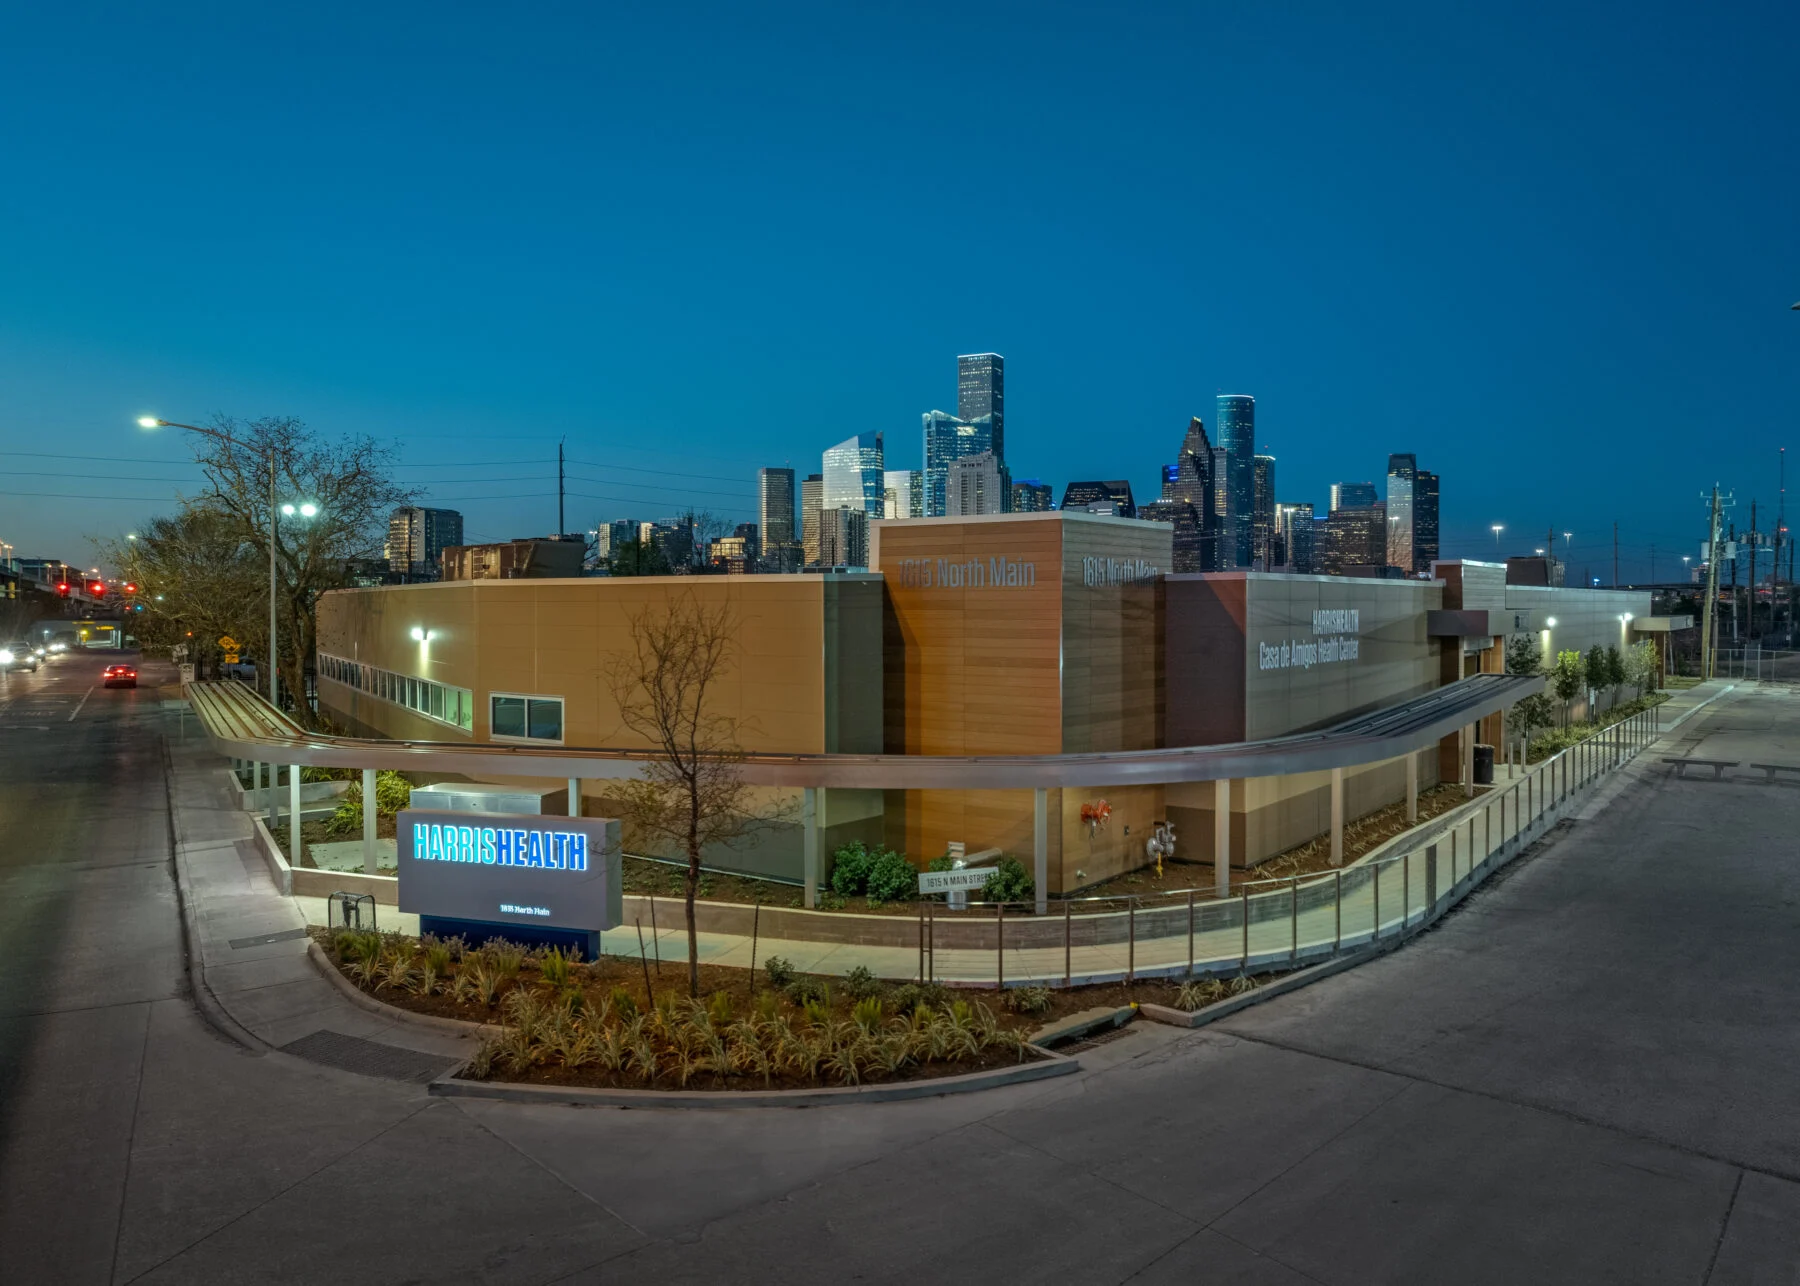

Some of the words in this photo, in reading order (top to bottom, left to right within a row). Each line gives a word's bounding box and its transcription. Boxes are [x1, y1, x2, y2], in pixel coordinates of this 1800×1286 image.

[937, 558, 984, 587] North
[989, 555, 1035, 587] Main
[1082, 557, 1104, 587] 1615
[1106, 557, 1133, 587] North
[1260, 641, 1280, 670] Casa
[1280, 639, 1290, 668] de
[1291, 640, 1317, 669] Amigos
[1317, 637, 1338, 663] Health
[1339, 635, 1358, 661] Center
[943, 877, 949, 886] N
[949, 875, 968, 885] MAIN
